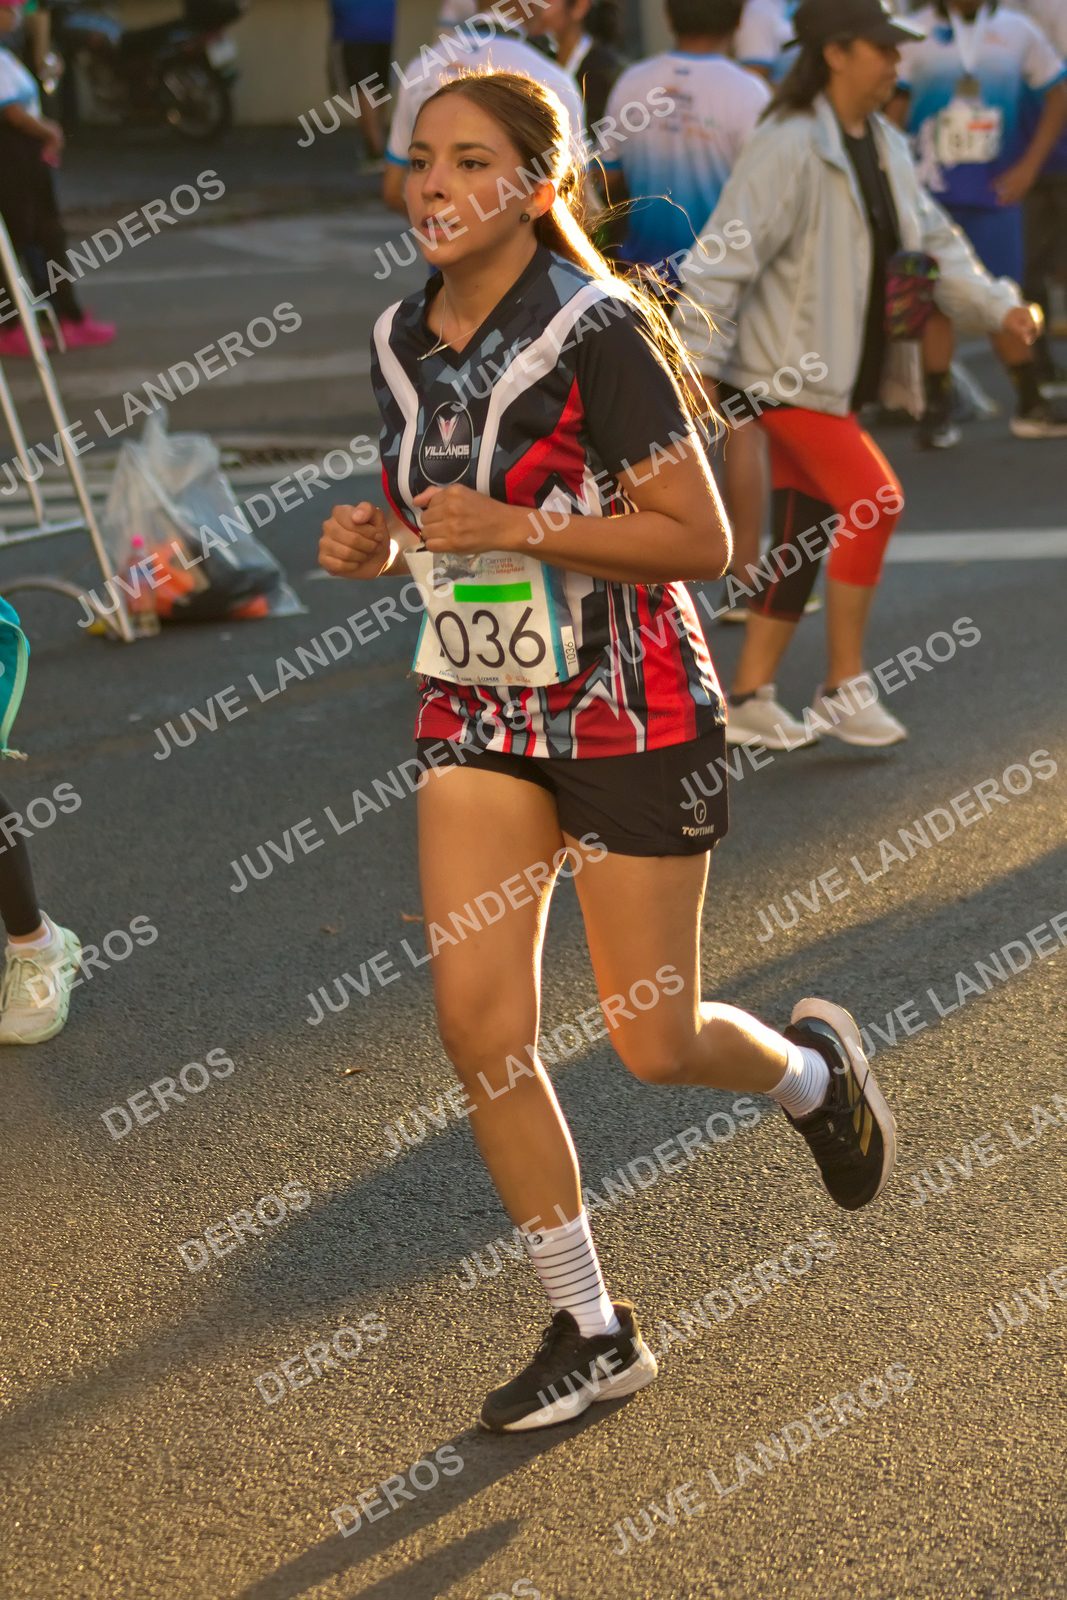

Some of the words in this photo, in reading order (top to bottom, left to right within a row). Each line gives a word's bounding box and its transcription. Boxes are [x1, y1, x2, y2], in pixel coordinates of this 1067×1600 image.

[425, 444, 470, 458] VILLANOS
[435, 606, 547, 669] 036
[565, 641, 577, 665] 1036
[682, 824, 715, 837] TOPTIME
